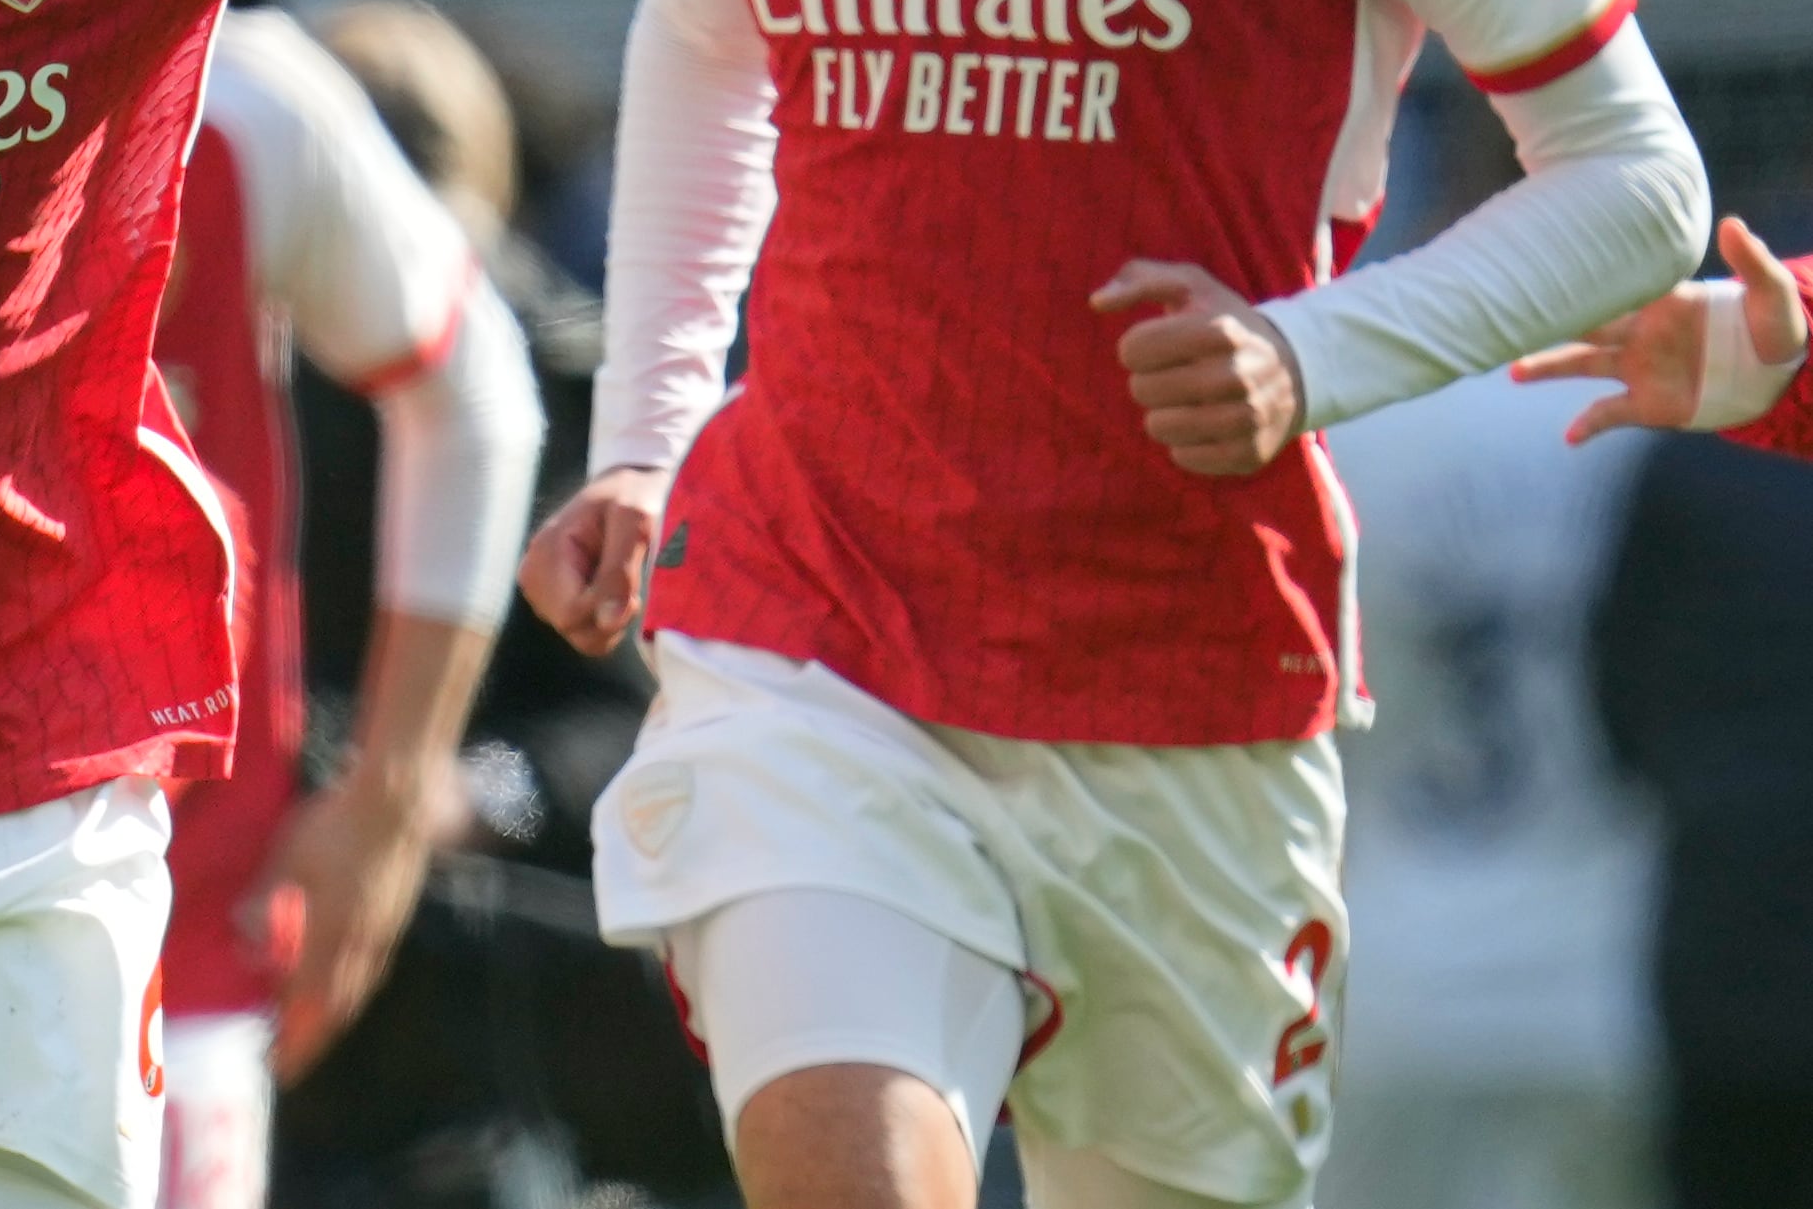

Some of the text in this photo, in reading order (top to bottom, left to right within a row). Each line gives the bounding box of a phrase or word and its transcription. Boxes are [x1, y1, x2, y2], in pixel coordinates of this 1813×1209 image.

[811, 48, 1121, 143] FLY BETTER
[1272, 918, 1333, 1088] 2
